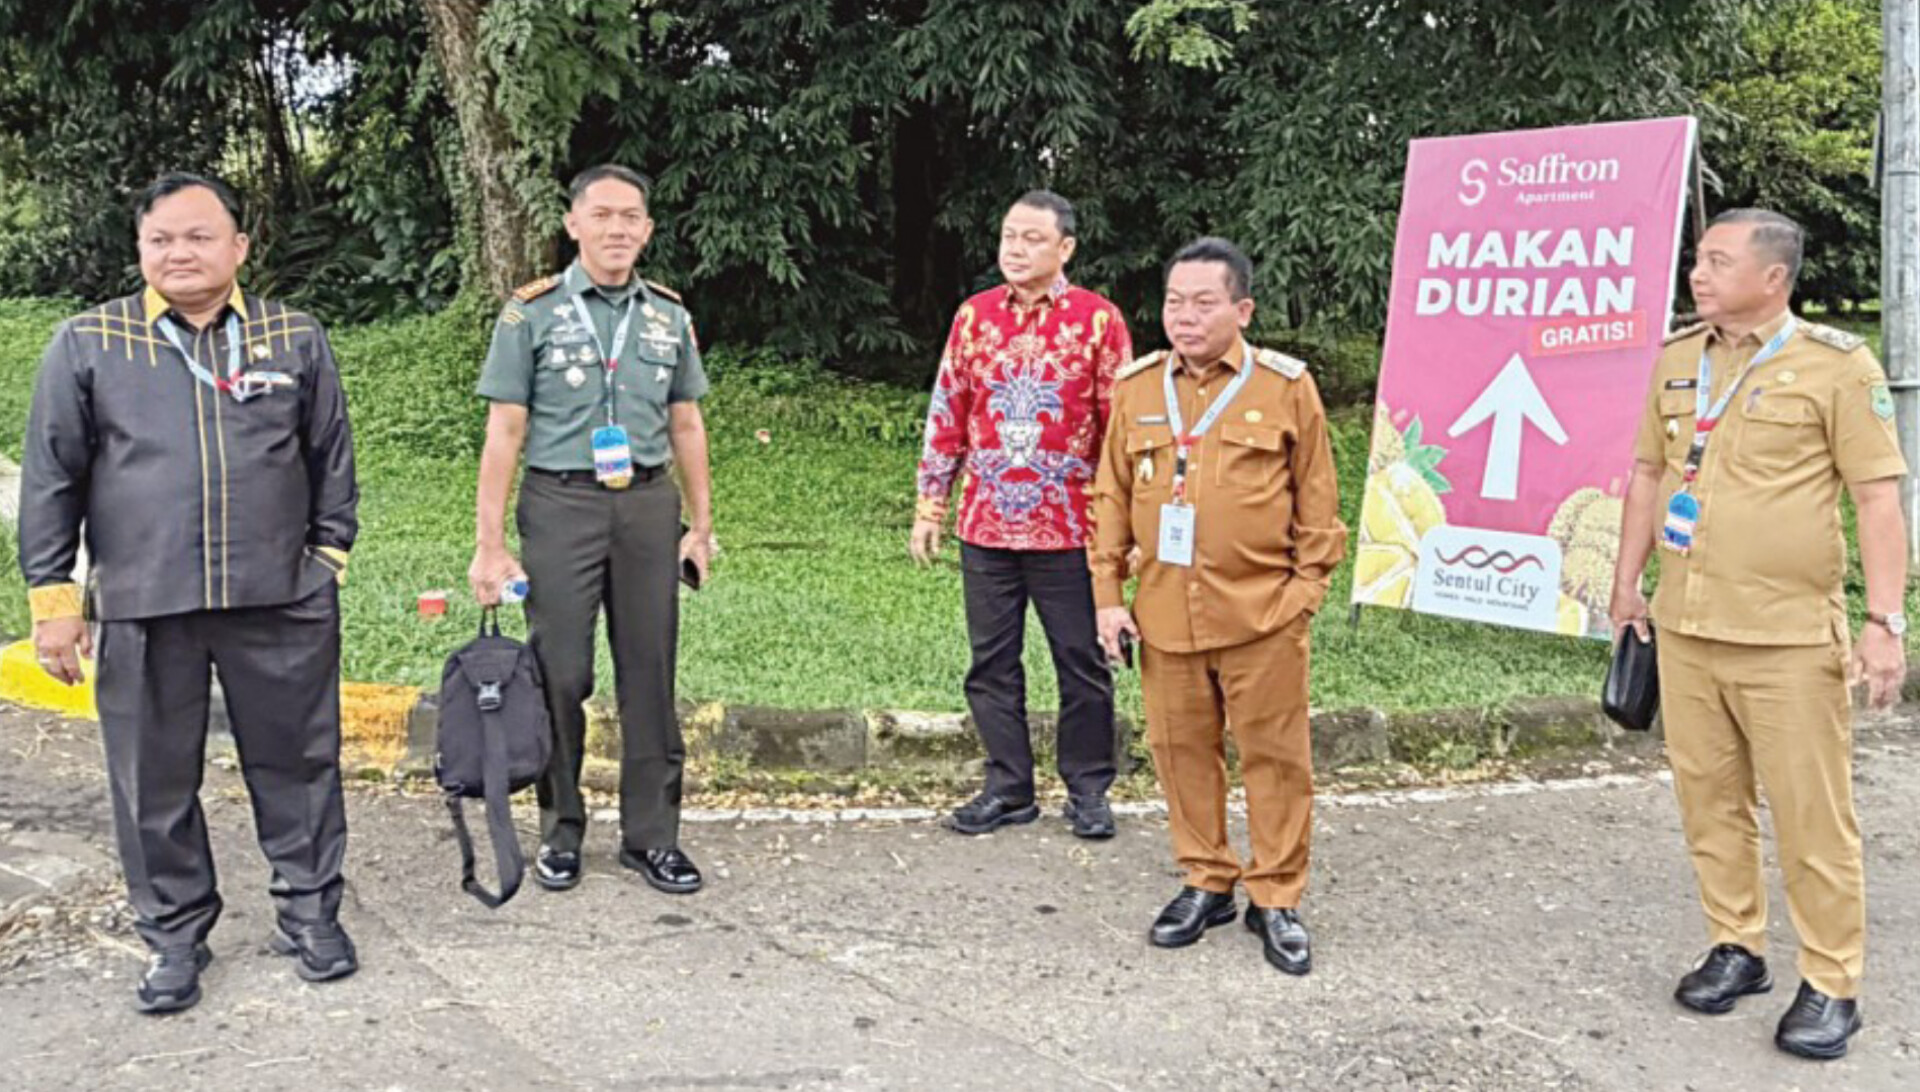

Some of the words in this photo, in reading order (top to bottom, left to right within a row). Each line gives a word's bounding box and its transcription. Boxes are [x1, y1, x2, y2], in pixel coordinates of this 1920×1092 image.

[1497, 152, 1619, 186] Saffron
[1516, 190, 1595, 205] Apartment
[1427, 226, 1634, 269] MAKAN
[1415, 276, 1636, 316] DURIAN
[1541, 321, 1634, 348] GRATIS!
[1433, 568, 1491, 592] Sentul
[1497, 577, 1540, 603] City
